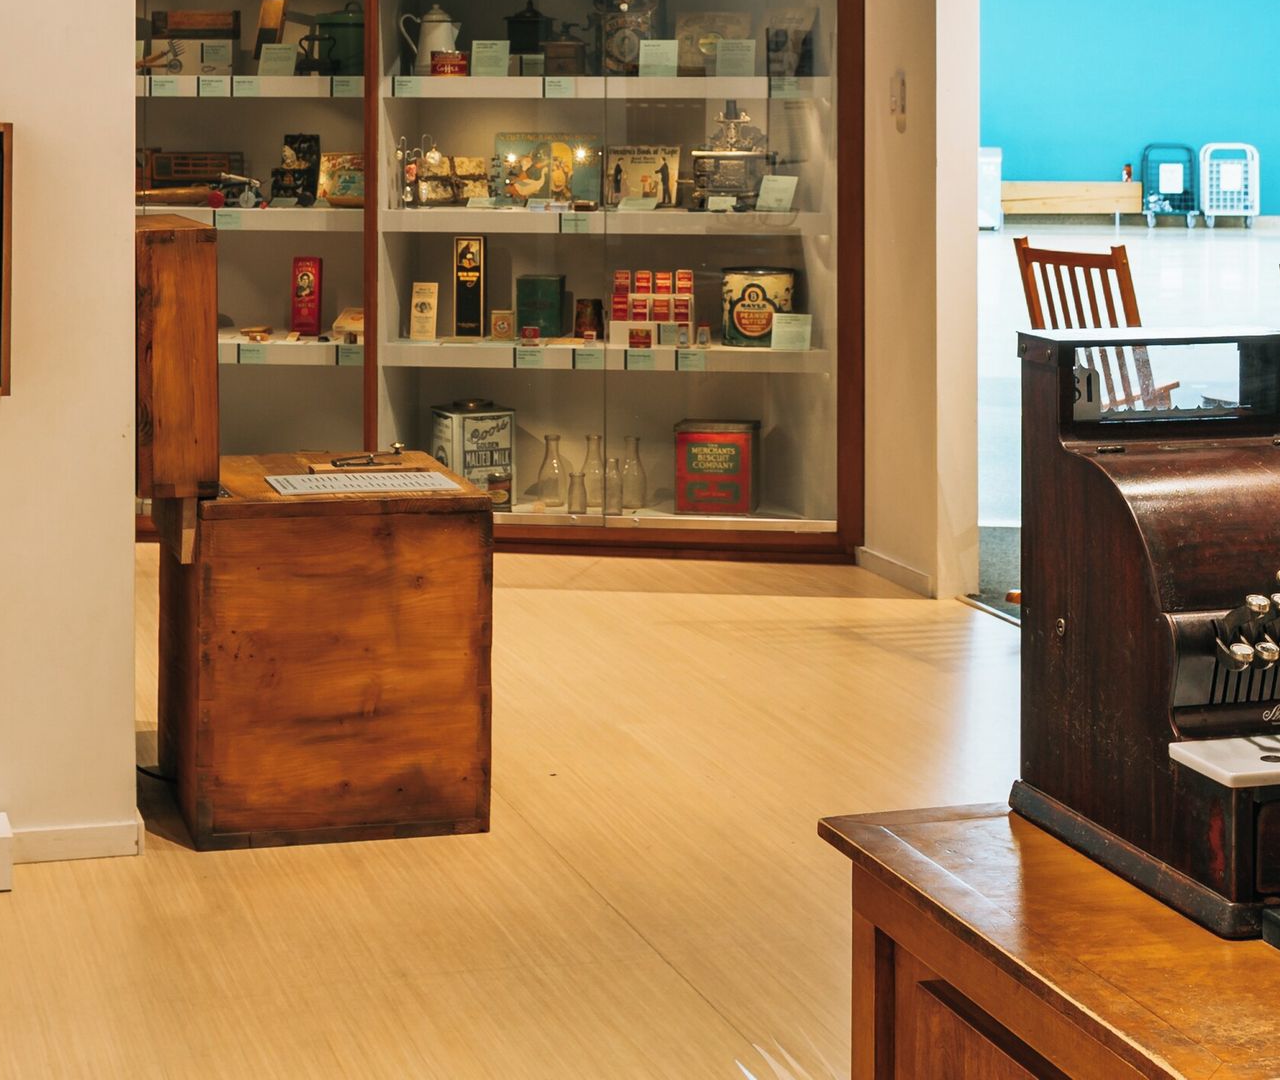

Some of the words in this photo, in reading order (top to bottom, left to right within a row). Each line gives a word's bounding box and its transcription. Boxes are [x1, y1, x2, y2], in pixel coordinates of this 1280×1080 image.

[691, 447, 736, 455] MERCHANTS
[465, 451, 491, 467] MALTED
[493, 450, 510, 466] MILK
[692, 461, 735, 469] COMPANY
